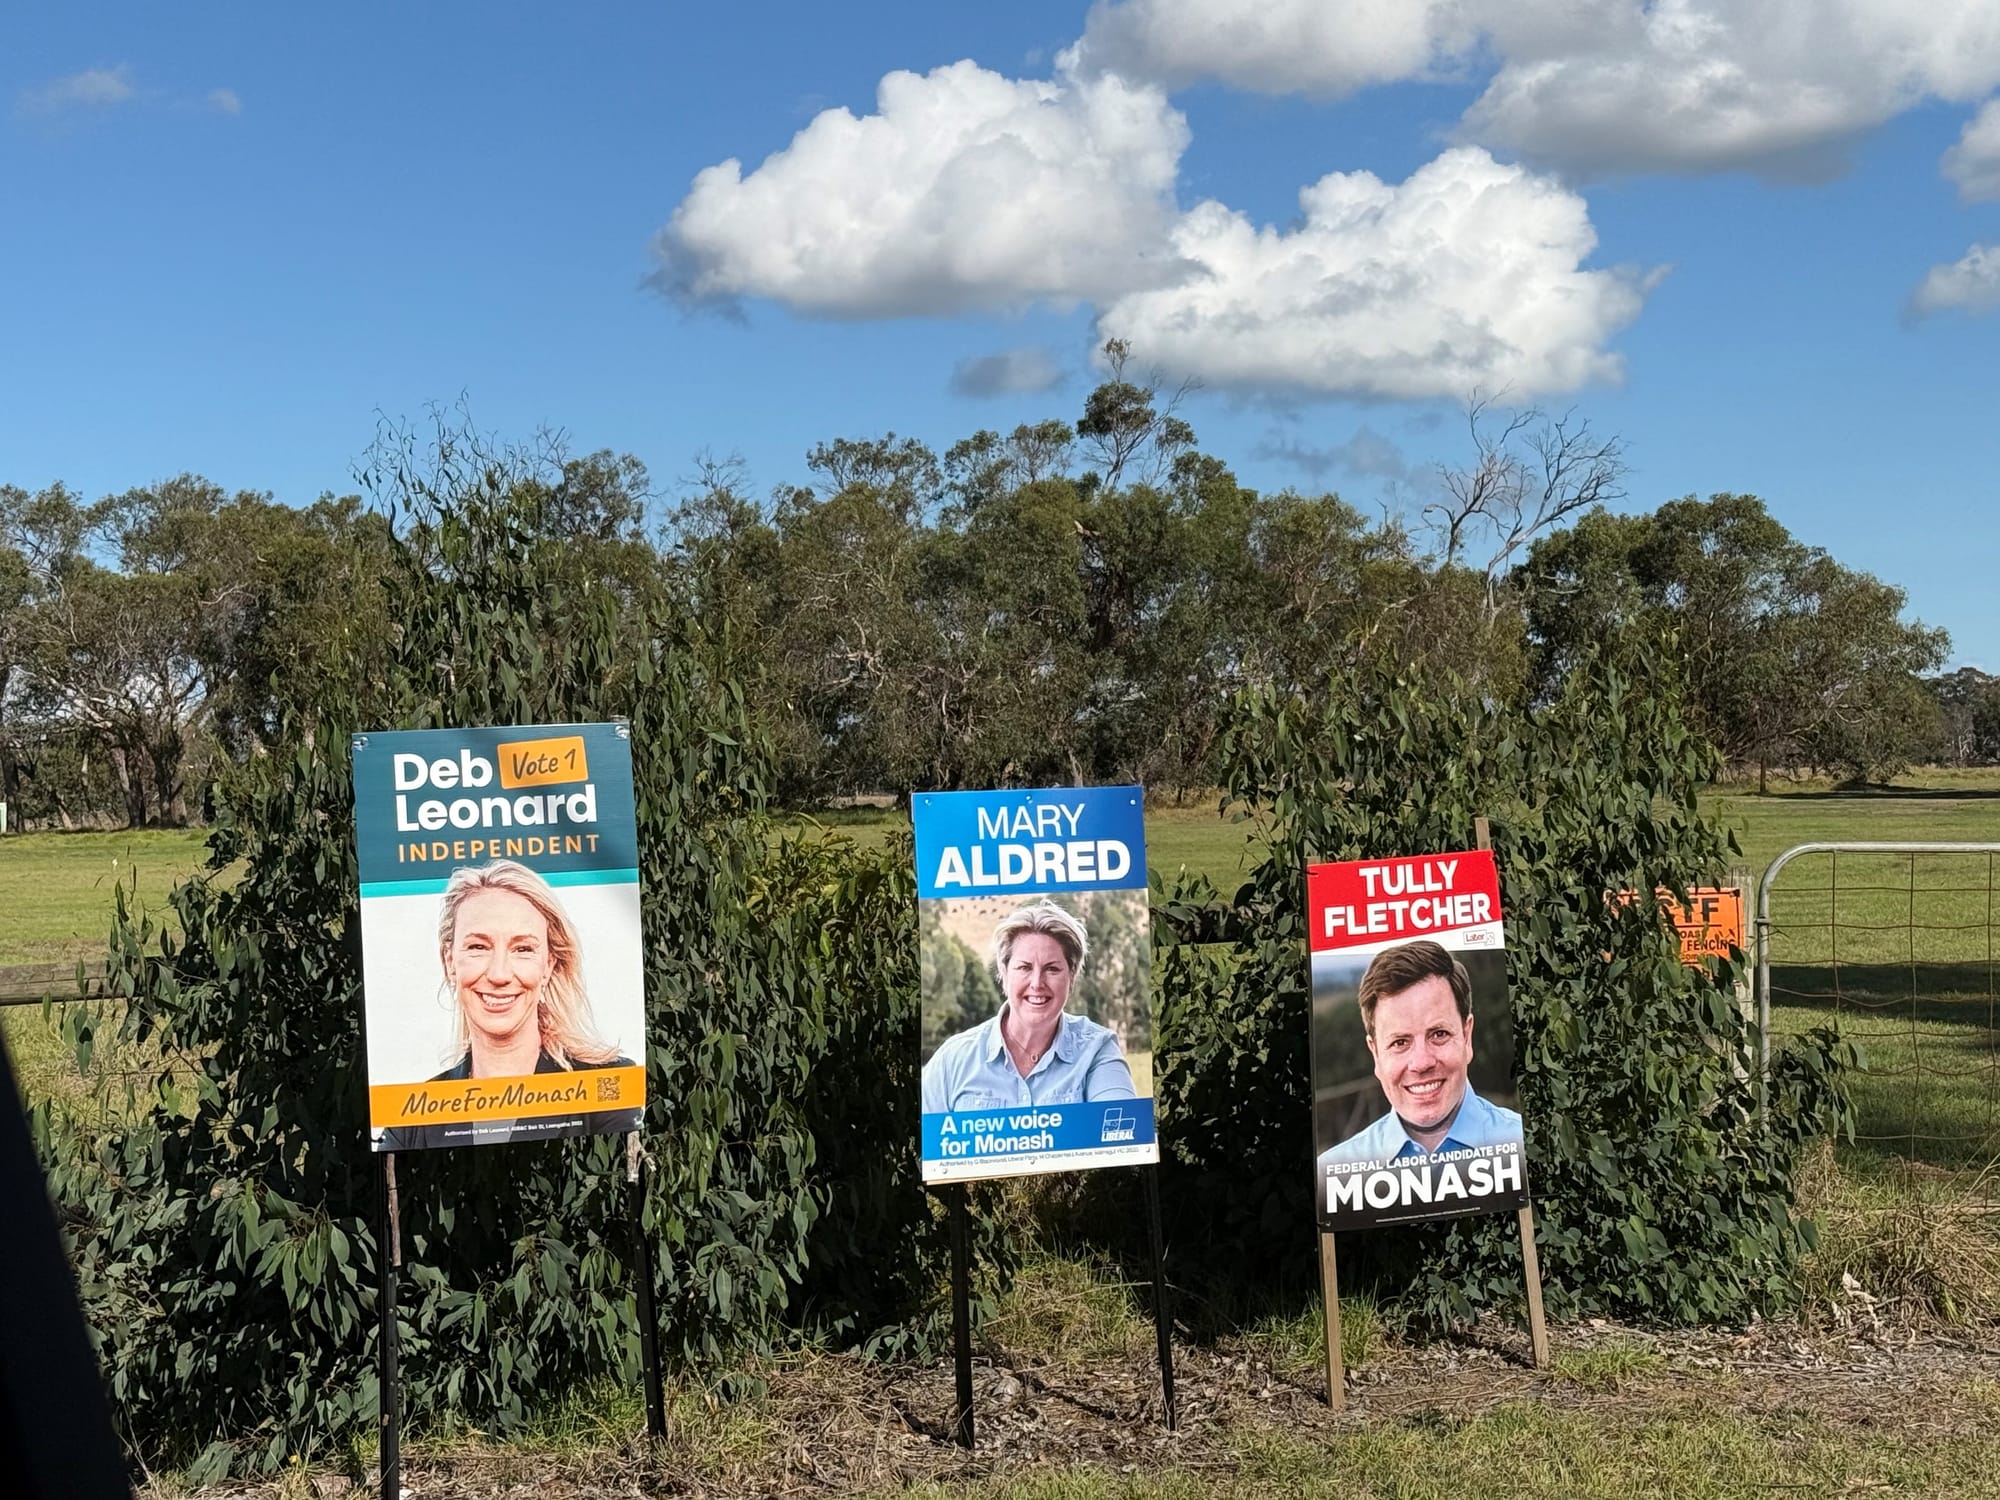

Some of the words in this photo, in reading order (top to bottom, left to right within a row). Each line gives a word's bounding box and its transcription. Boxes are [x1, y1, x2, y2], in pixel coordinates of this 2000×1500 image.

[393, 749, 493, 791] Deb
[512, 750, 559, 780] Vote
[564, 748, 577, 771] 1
[396, 784, 598, 832] Leonard
[977, 803, 1085, 840] MARY
[399, 834, 600, 863] INDEPENDENT
[934, 840, 1131, 889] ALDRED
[1359, 859, 1458, 898] TULLY
[1324, 893, 1492, 938] FLETCHER
[401, 1080, 588, 1117] MoreForMonash
[940, 1115, 957, 1136] A
[961, 1116, 1005, 1134] new
[1009, 1109, 1063, 1130] voice
[1101, 1130, 1135, 1142] LIBERAL
[940, 1139, 970, 1157] for
[974, 1130, 1054, 1154] Monash
[1326, 1161, 1385, 1175] FEDERAL
[1386, 1155, 1428, 1169] LABOR
[1429, 1146, 1494, 1163] CANDIDATE
[1495, 1142, 1518, 1155] FOR
[1326, 1154, 1522, 1214] MONASH
